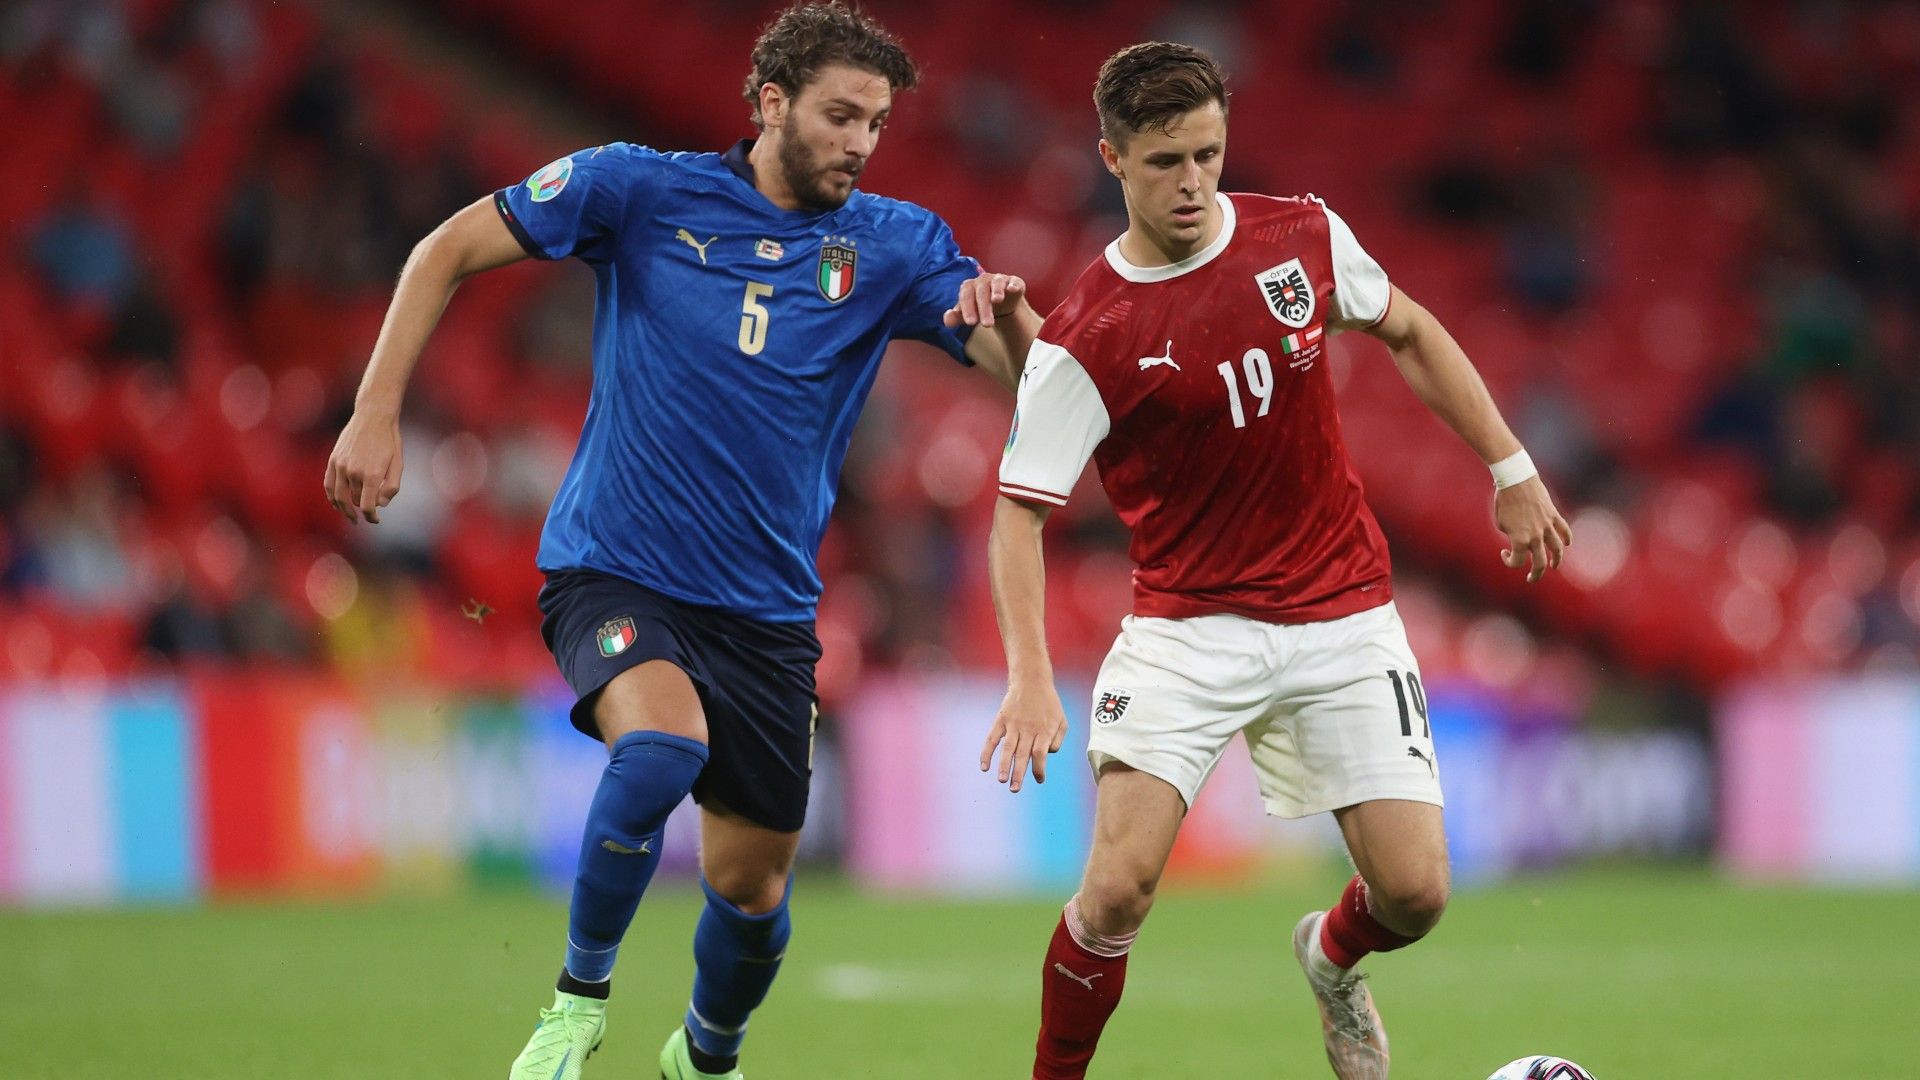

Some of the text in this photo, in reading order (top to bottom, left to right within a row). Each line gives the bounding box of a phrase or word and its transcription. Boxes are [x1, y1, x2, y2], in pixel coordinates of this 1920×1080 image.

[823, 249, 853, 261] ITALIA
[738, 281, 774, 355] 5
[1217, 348, 1273, 428] 19
[1386, 670, 1429, 739] 19
